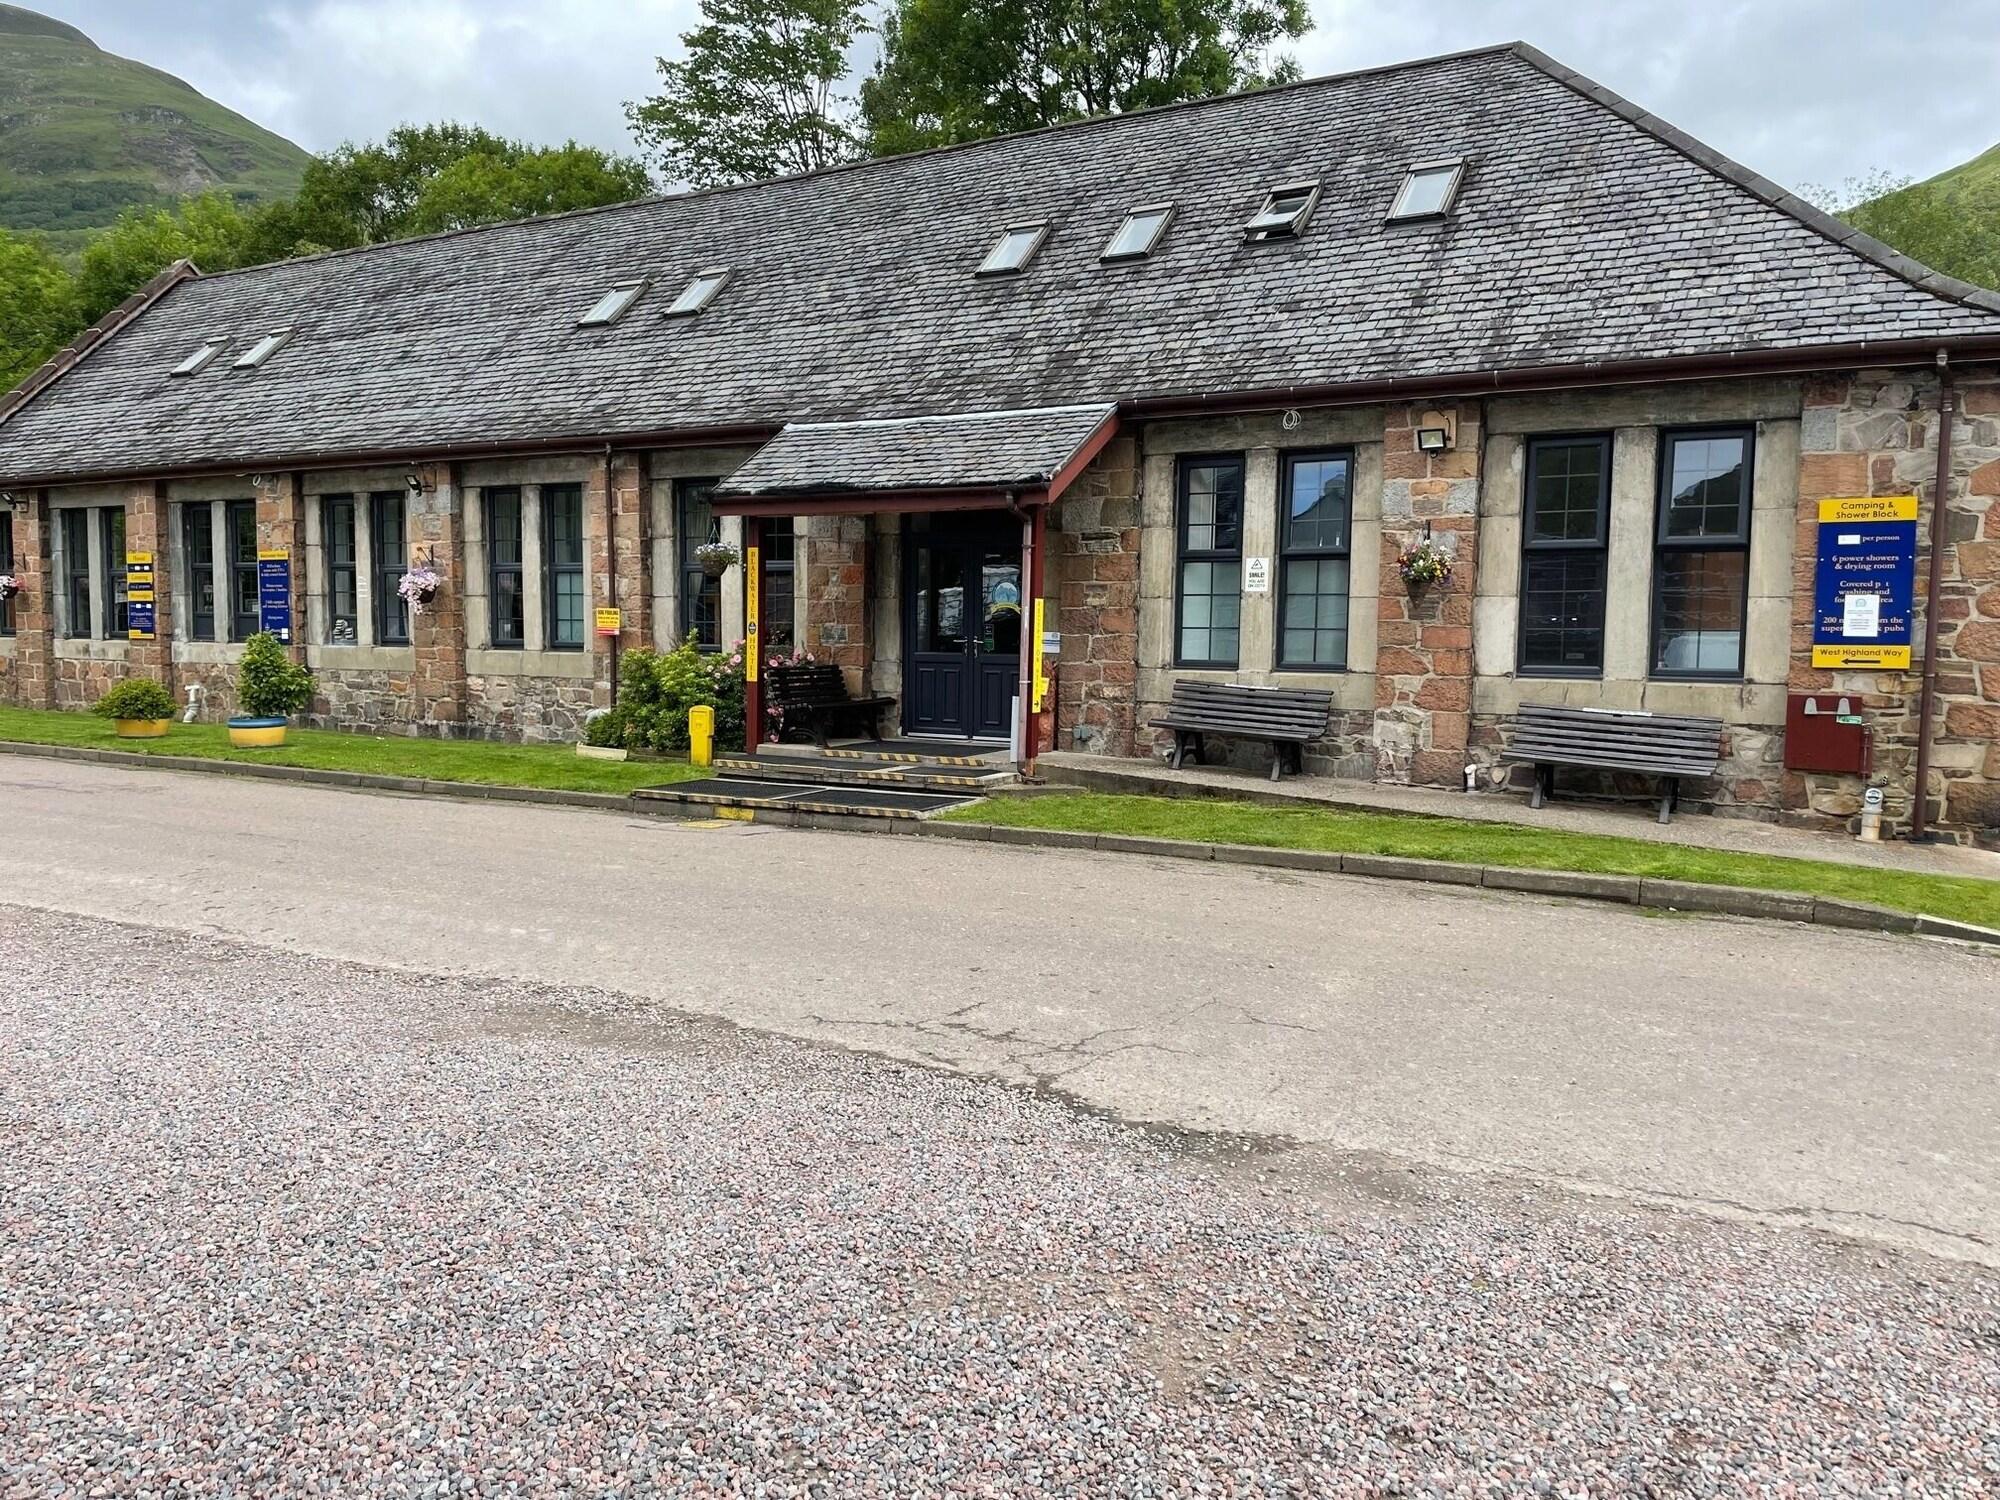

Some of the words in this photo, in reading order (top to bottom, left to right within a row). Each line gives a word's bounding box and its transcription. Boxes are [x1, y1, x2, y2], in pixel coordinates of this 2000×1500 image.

[1841, 502, 1885, 511] Camping
[1836, 511, 1870, 519] Shower
[1873, 510, 1899, 518] Block
[1865, 554, 1900, 562] showers
[1844, 563, 1872, 571] drying
[1823, 616, 1837, 624] 200
[1884, 625, 1905, 633] pubs
[1820, 648, 1840, 656] West
[1843, 648, 1881, 657] Highland
[1884, 649, 1903, 657] Way
